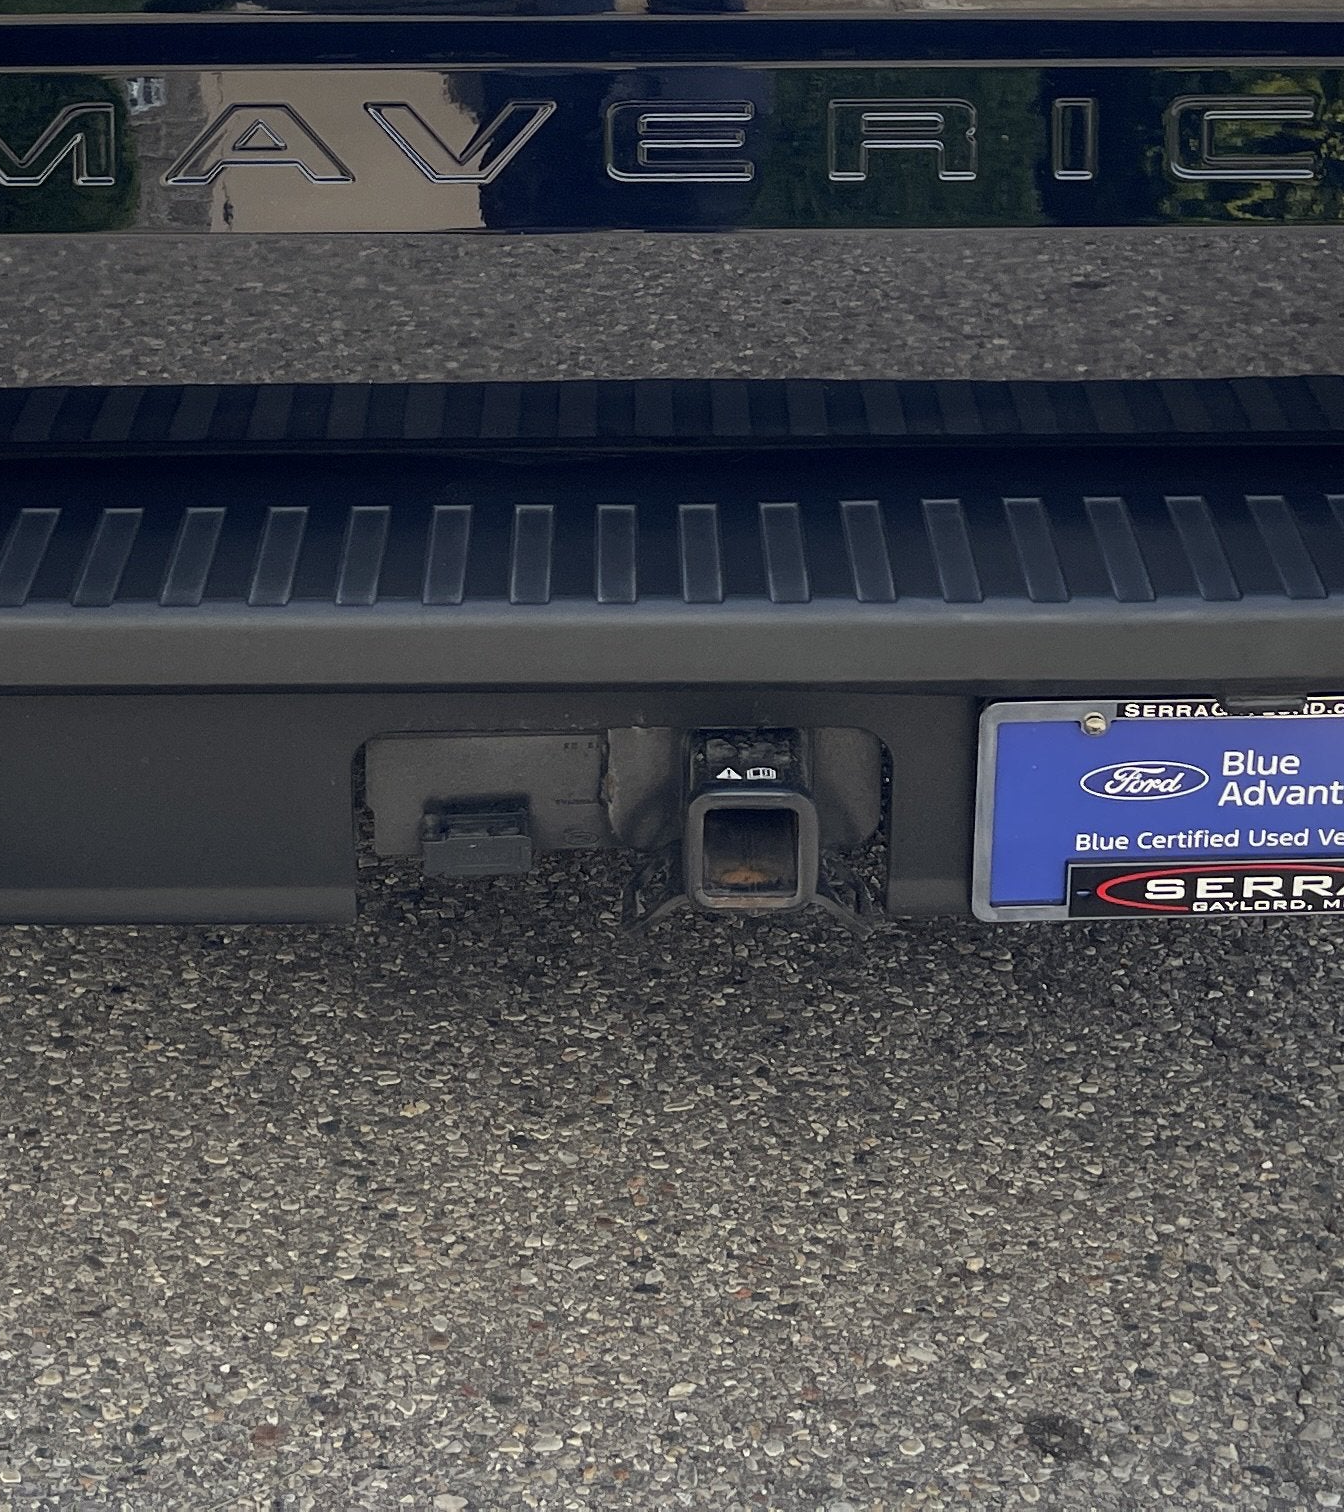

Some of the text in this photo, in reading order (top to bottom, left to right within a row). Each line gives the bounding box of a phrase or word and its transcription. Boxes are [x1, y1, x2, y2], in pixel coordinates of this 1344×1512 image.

[1222, 749, 1301, 777] Blue
[1104, 765, 1185, 794] Ford
[1075, 833, 1129, 852] Blue
[1137, 829, 1240, 850] Certified
[1248, 828, 1310, 848] Used
[1192, 899, 1313, 912] GAYLORD,
